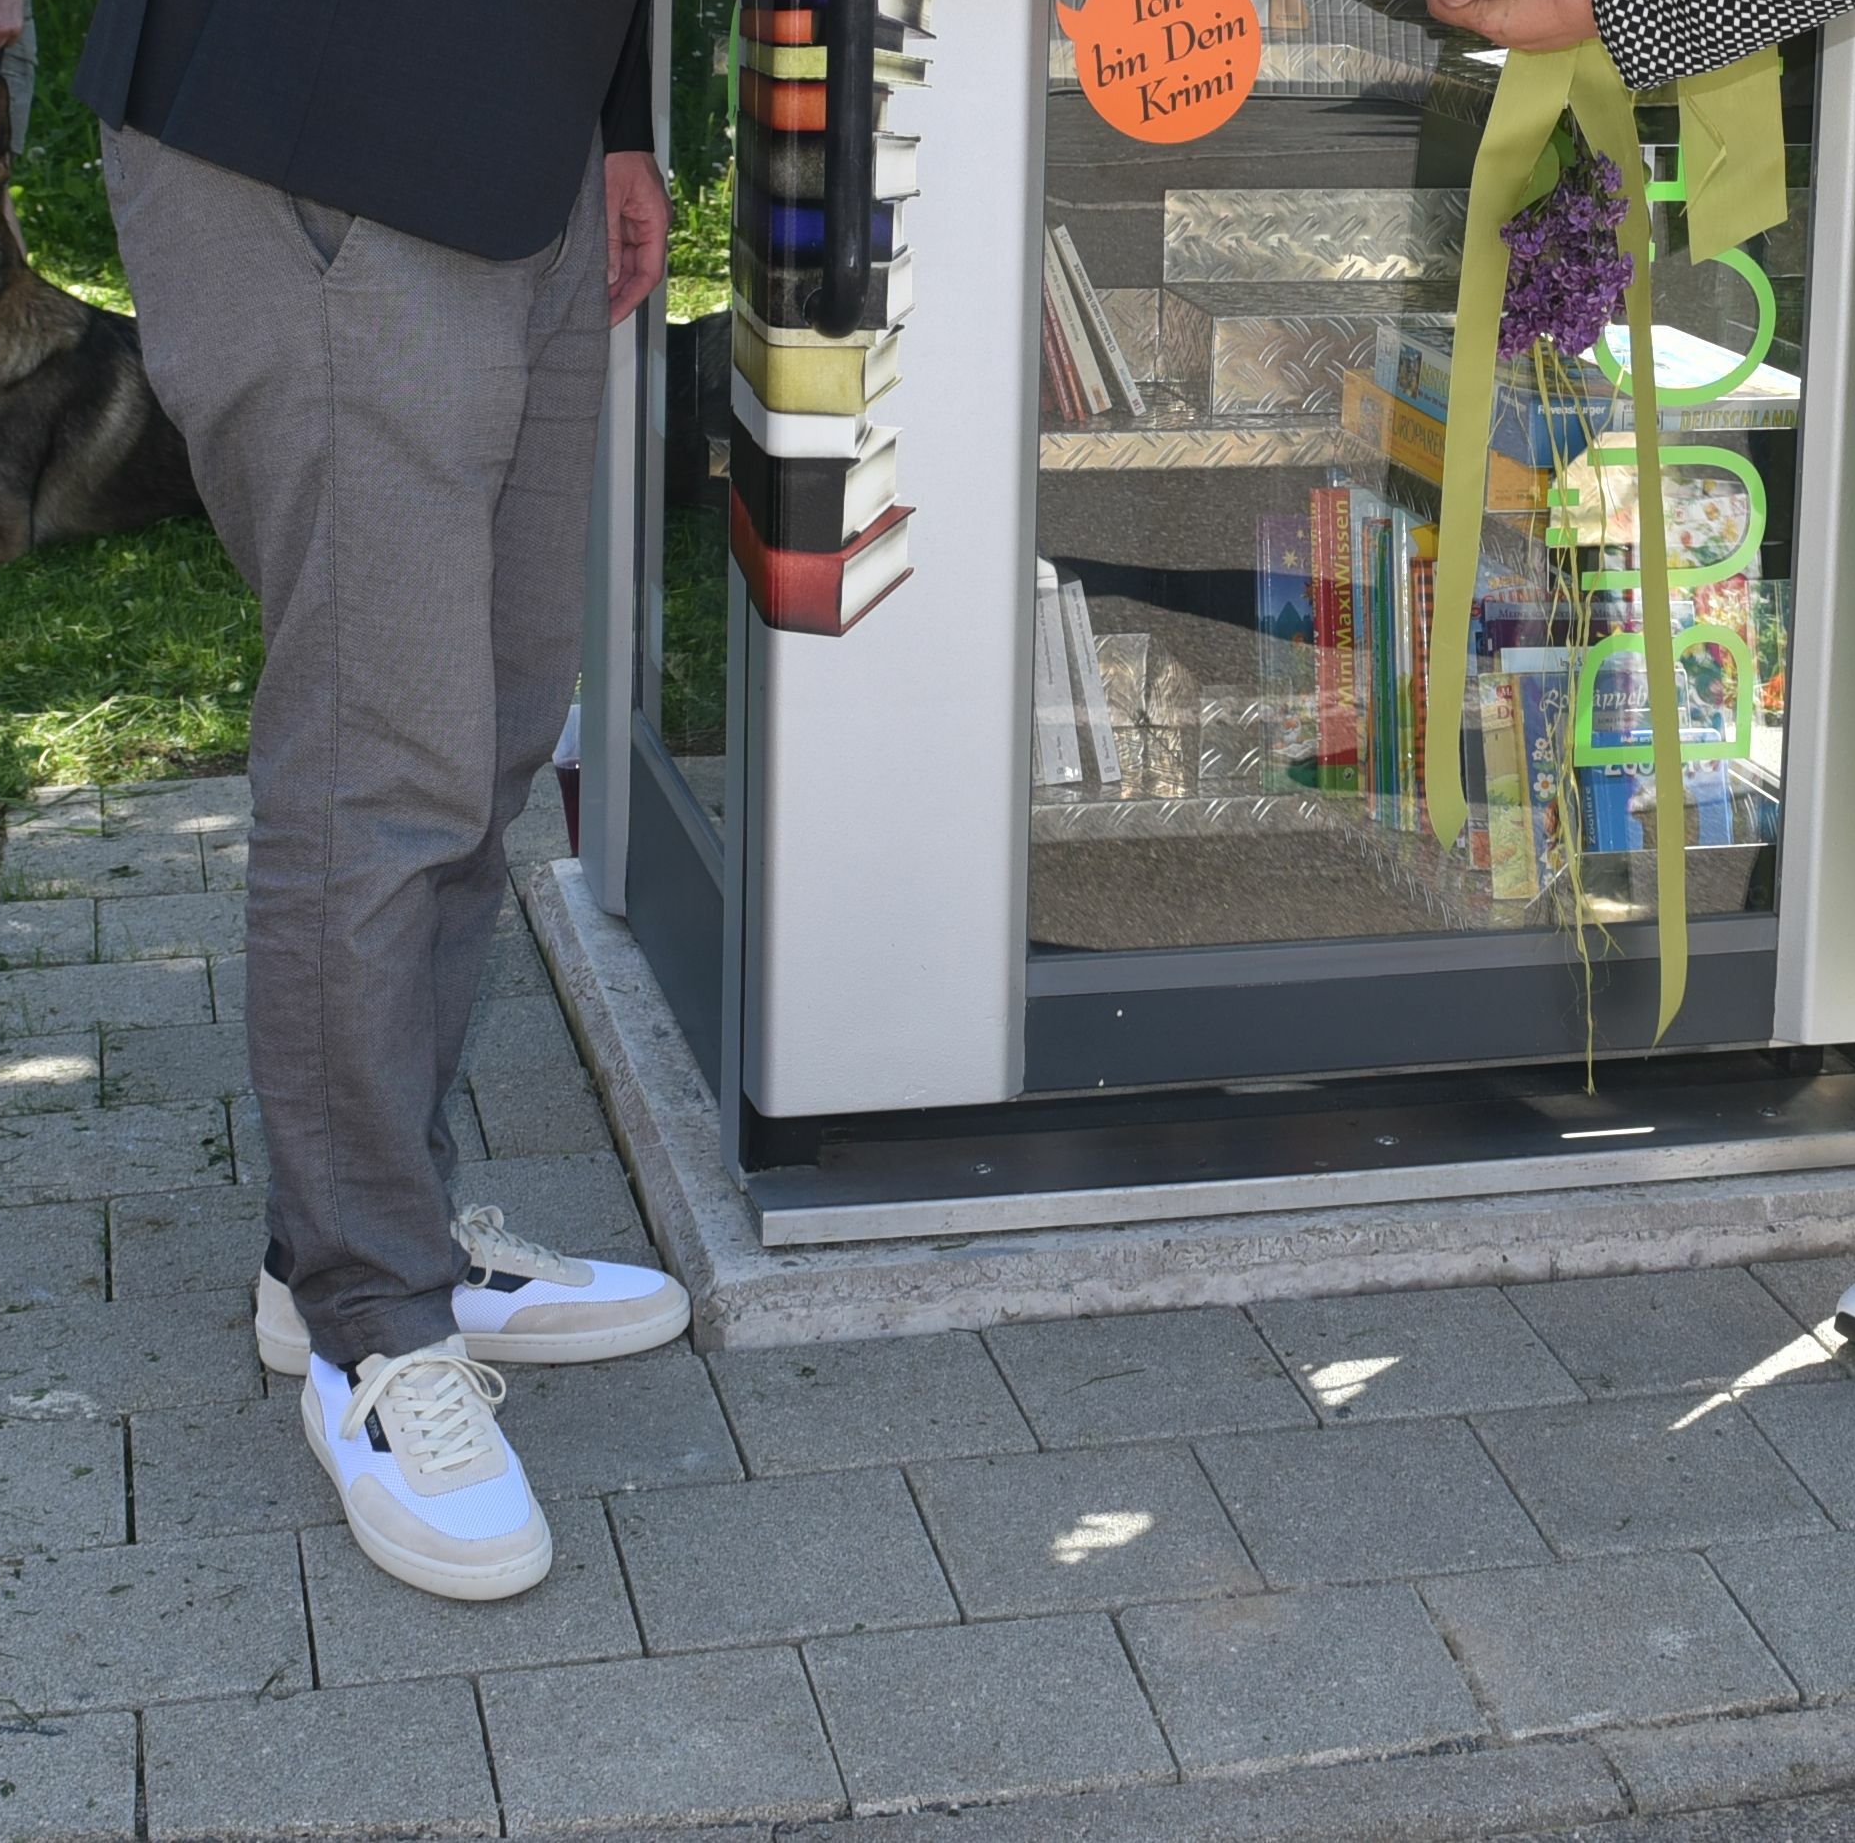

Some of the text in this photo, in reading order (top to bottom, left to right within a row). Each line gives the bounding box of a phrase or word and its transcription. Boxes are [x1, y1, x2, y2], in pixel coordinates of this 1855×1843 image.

[1091, 11, 1248, 89] bin Dein
[1135, 58, 1235, 125] Krimi
[1537, 403, 1607, 417] Rvensurger
[1335, 499, 1354, 709] MiniMaxiWissen
[1583, 785, 1596, 845] Zootiere
